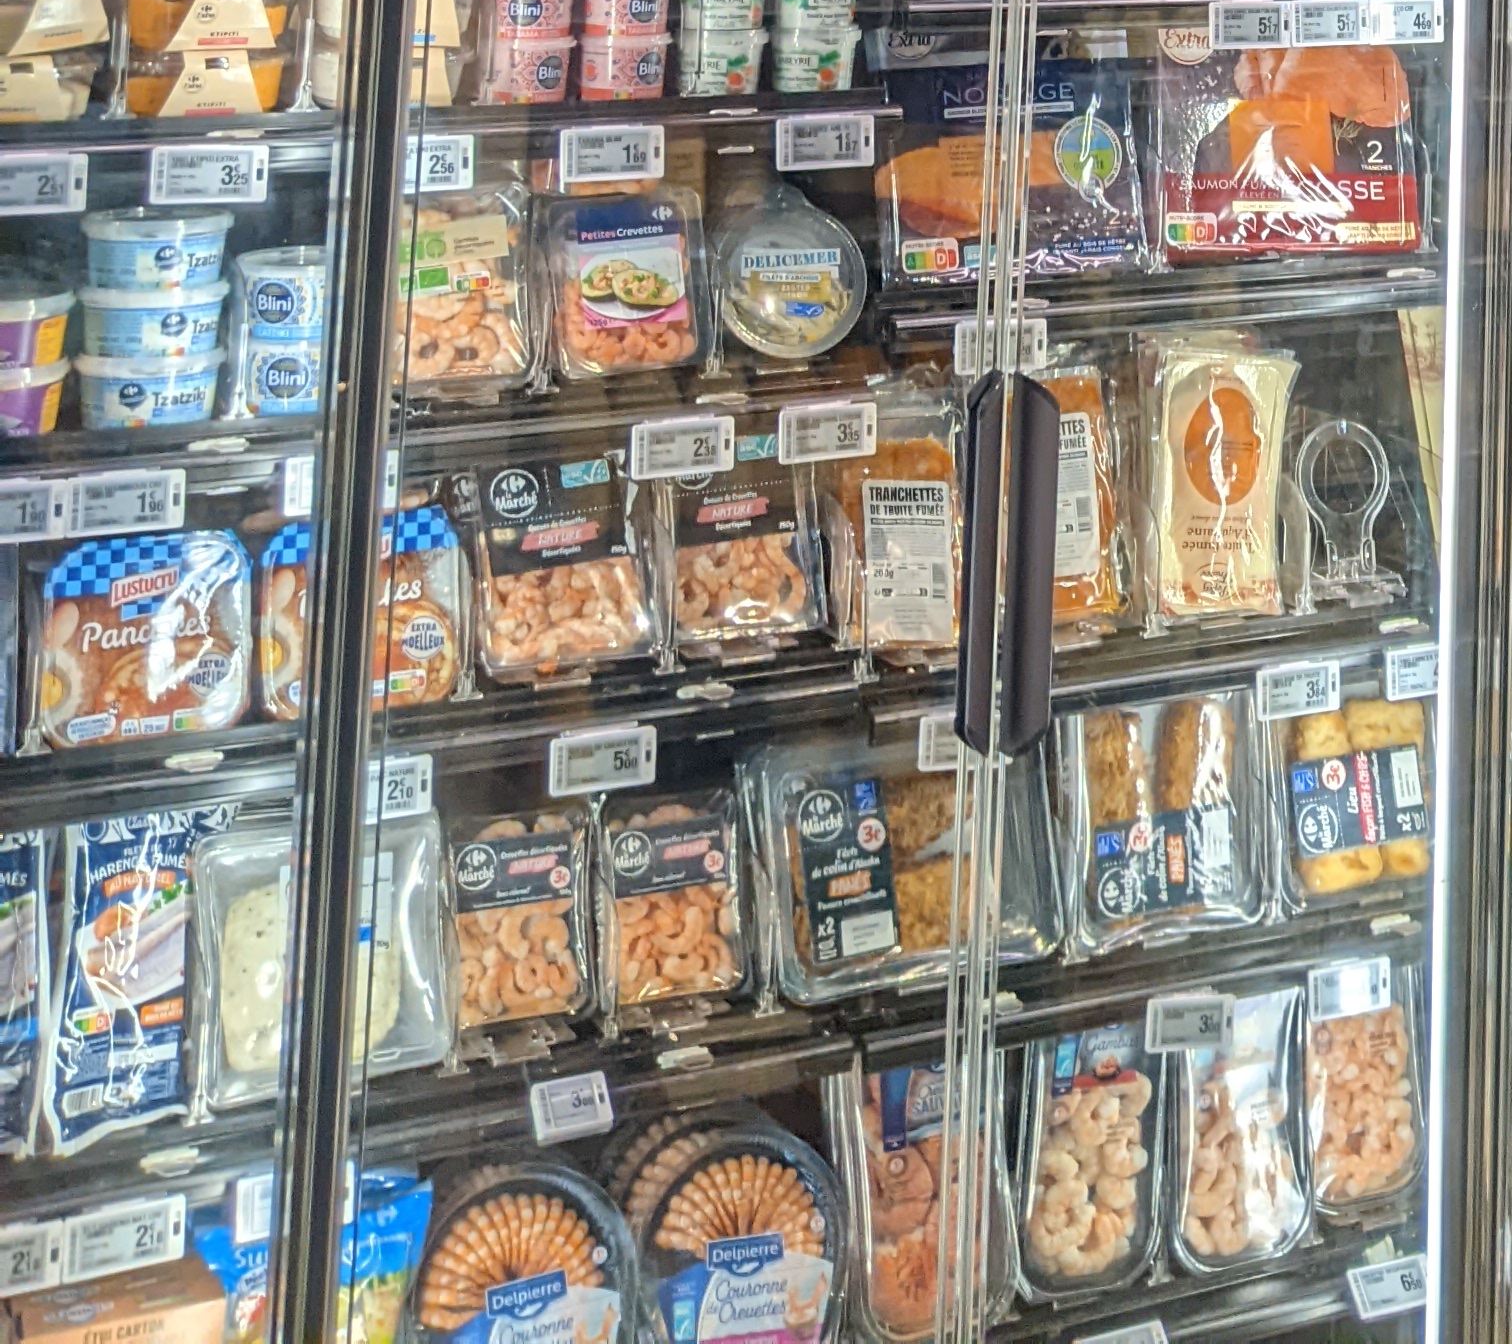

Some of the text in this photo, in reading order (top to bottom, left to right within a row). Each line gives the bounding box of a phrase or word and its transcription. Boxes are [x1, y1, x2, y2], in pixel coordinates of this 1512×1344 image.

[510, 3, 541, 17] Blini
[1163, 29, 1211, 50] Extra
[1366, 141, 1385, 164] 2
[1180, 178, 1239, 191] SAUMON
[580, 224, 664, 242] Petites Crevettes
[743, 250, 838, 269] DELICEMER
[257, 293, 293, 313] Blini
[268, 369, 307, 388] Blini
[152, 388, 207, 408] Tzatziki
[495, 492, 538, 511] Marché
[868, 486, 945, 503] TRANCHETTES
[712, 505, 753, 519] NATURE
[870, 502, 945, 517] DE TRUITE FUMÉE
[537, 529, 581, 546] NATURE
[111, 566, 178, 605] LUSTUCRU
[410, 622, 437, 634] EXTRA
[401, 630, 445, 650] MOELLEUX
[1347, 786, 1358, 814] Lieu
[802, 813, 844, 837] Marché
[1321, 803, 1334, 849] Marché
[1395, 812, 1411, 831] x2
[615, 853, 650, 869] Marché
[457, 865, 495, 884] Marché
[817, 916, 836, 937] x2
[712, 1242, 779, 1265] Delpierre
[491, 1279, 563, 1310] Delpierre
[715, 1278, 789, 1302] Couronne
[719, 1301, 787, 1323] Crevettes
